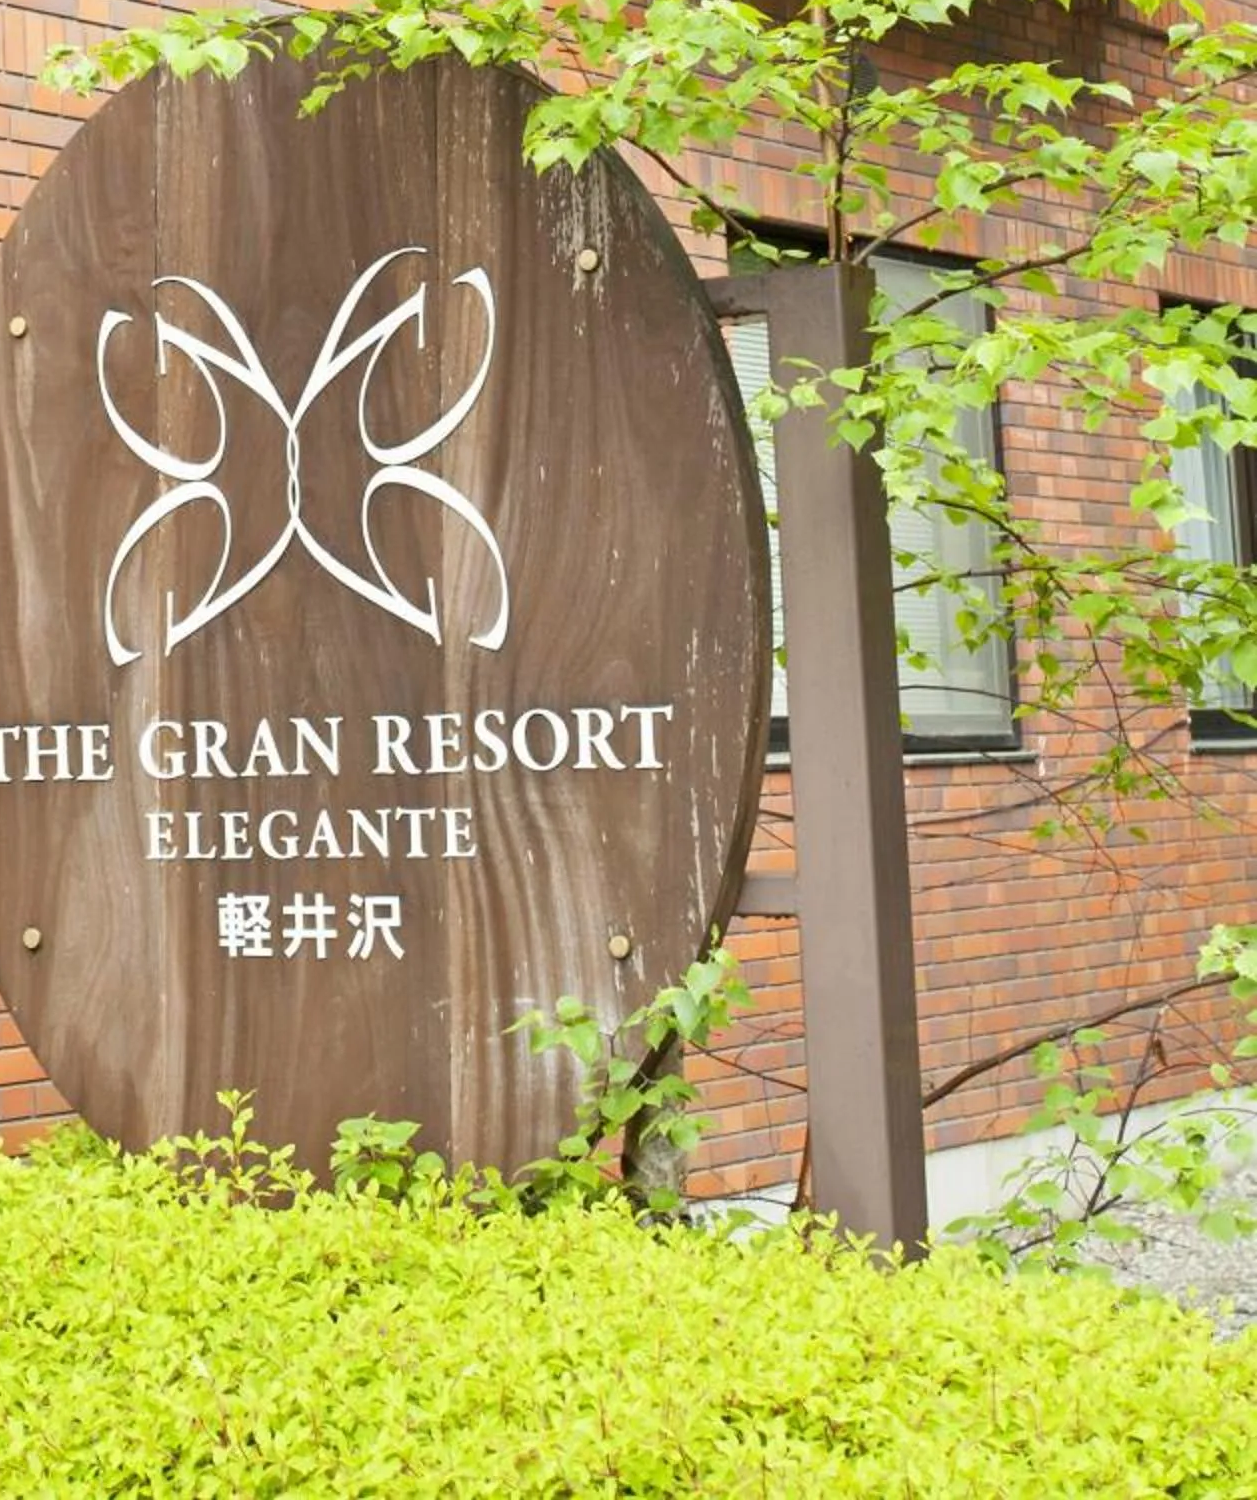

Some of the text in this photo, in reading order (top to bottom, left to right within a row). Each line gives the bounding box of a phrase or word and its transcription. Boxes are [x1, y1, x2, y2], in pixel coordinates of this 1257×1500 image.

[139, 717, 343, 779] GRAN
[372, 704, 673, 775] RESORT
[145, 807, 477, 860] ELEGANTE
[218, 892, 405, 959] 軽井沢
